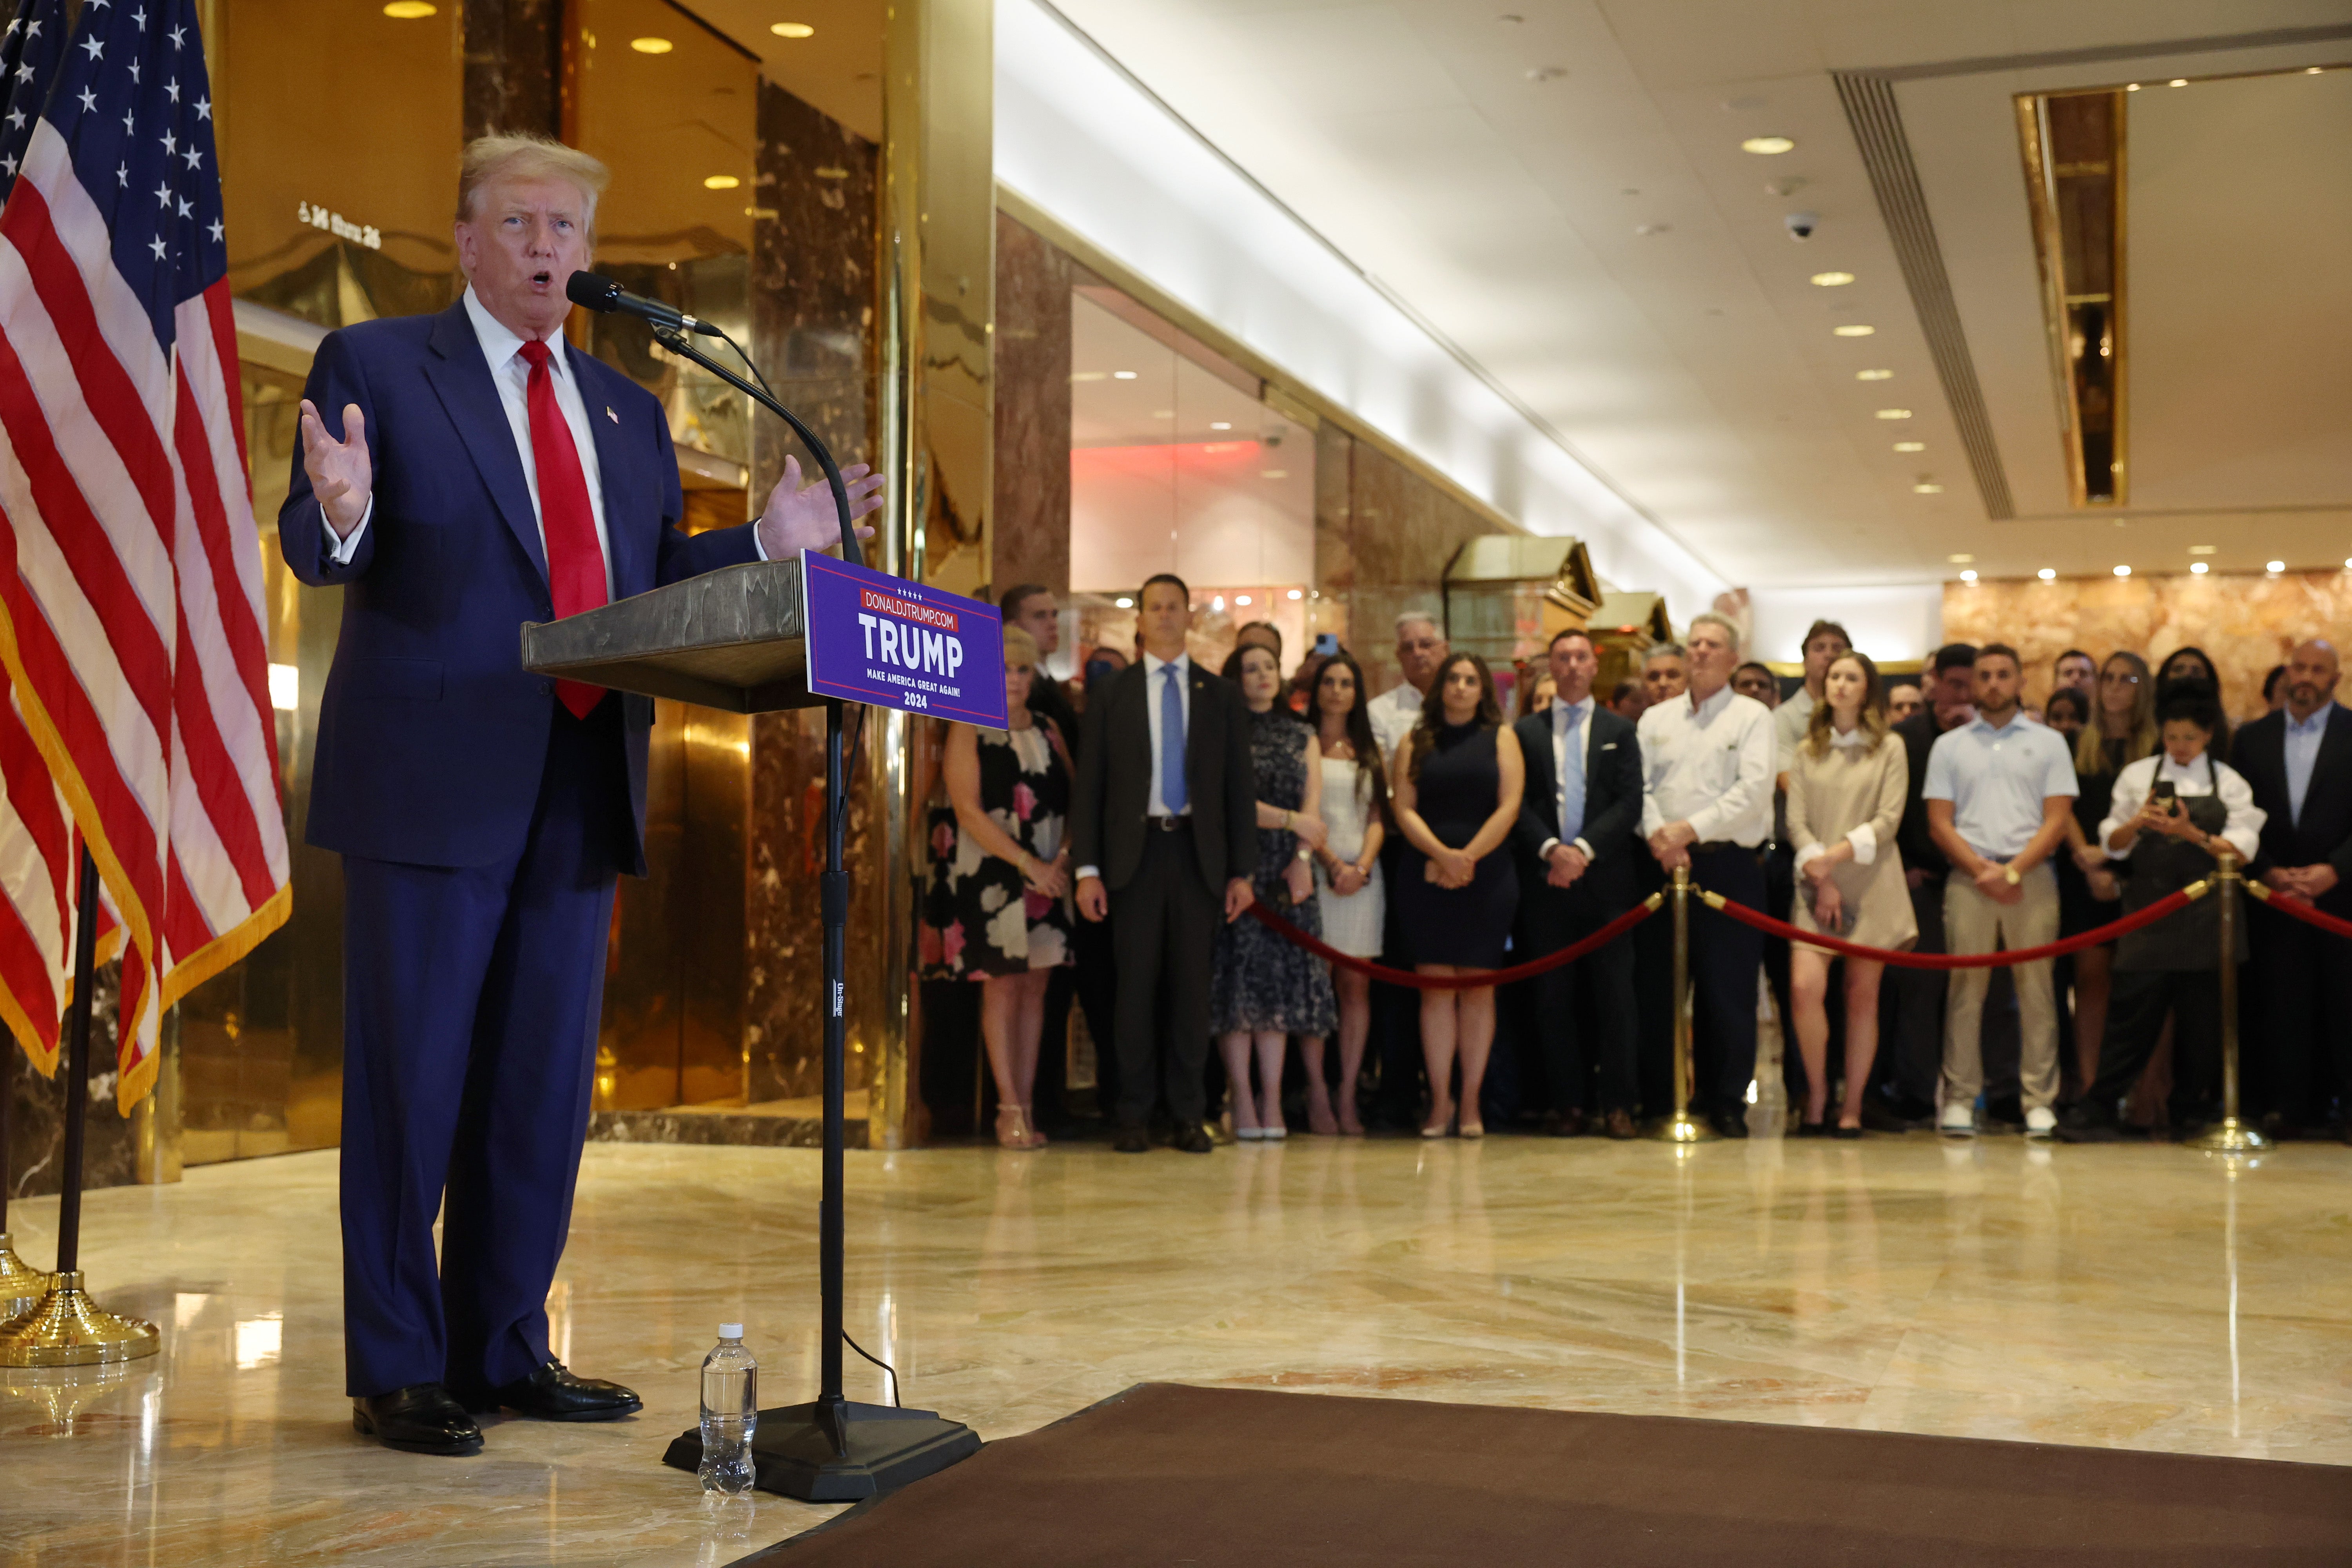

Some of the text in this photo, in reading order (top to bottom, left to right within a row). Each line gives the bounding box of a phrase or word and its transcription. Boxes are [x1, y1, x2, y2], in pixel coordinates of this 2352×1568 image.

[866, 592, 954, 629] DONALDJTRUMP.COM
[858, 612, 963, 678] TRUMP
[867, 668, 960, 698] MAKE AMERICA GREAT AGAIN!
[904, 691, 927, 709] 2024
